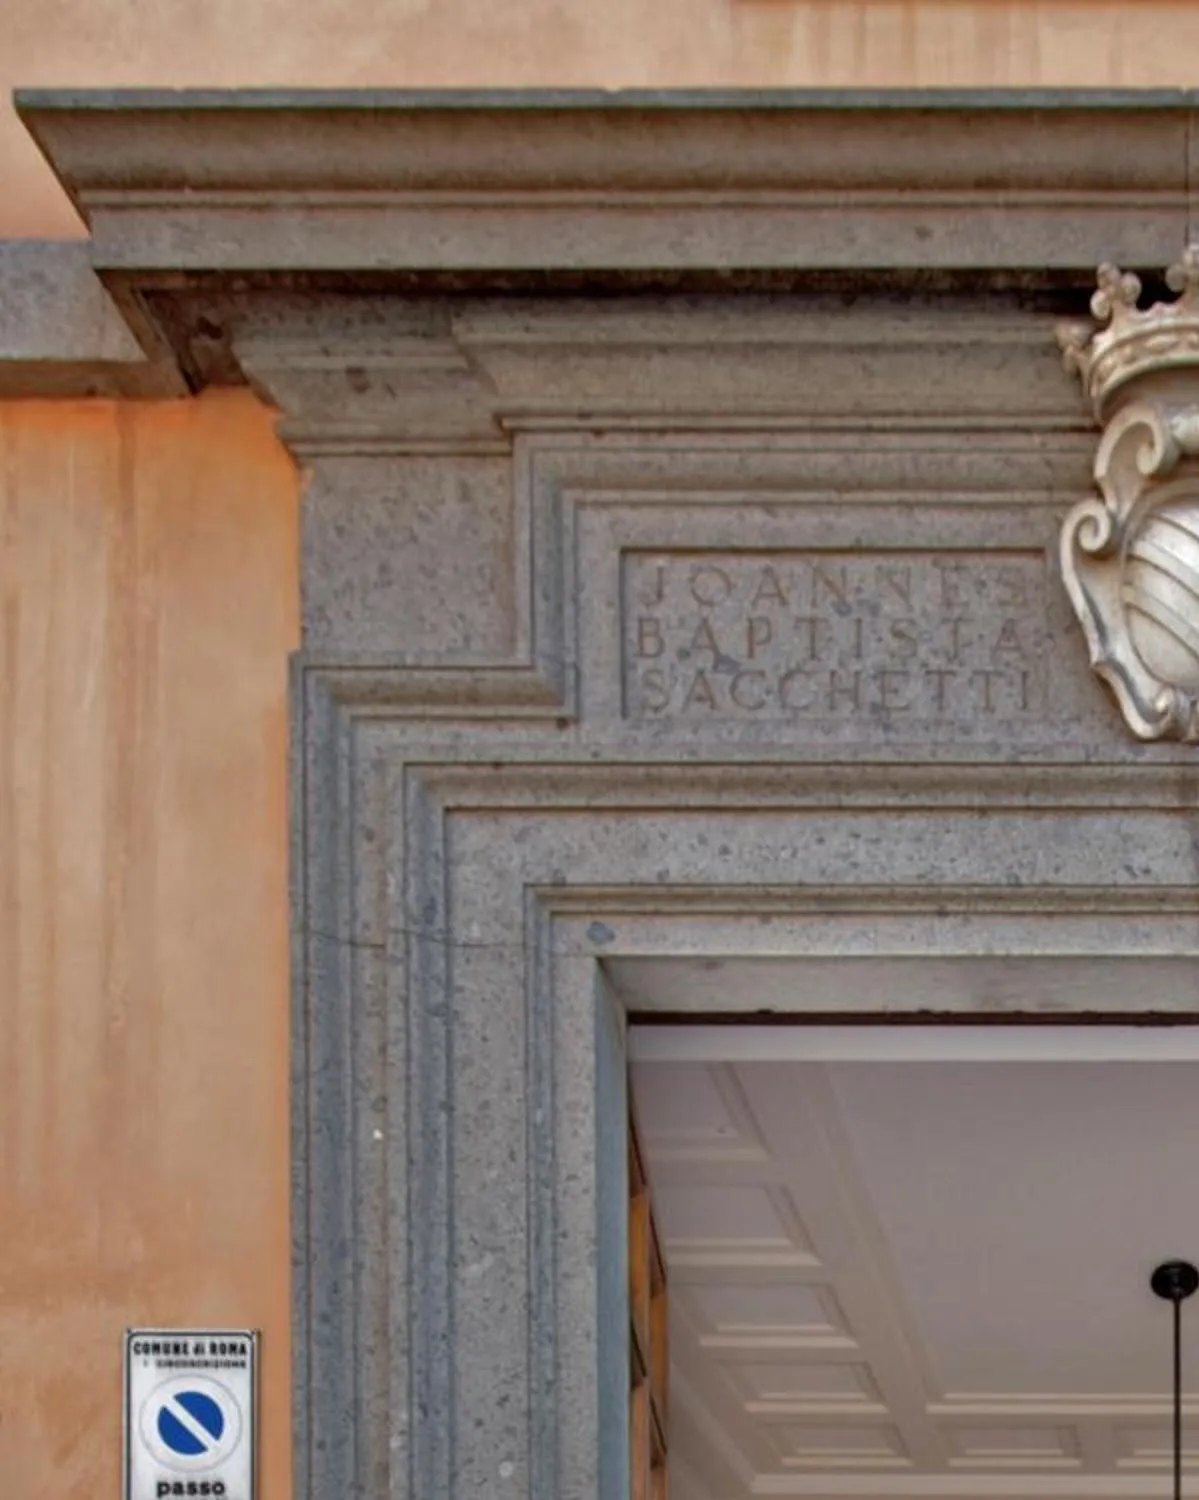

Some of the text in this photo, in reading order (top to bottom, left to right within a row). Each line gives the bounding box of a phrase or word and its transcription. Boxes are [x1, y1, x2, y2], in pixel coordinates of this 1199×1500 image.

[634, 616, 1026, 662] BAPTISTA
[638, 668, 1032, 714] SACCHETTI
[133, 1342, 247, 1356] COMUNE di ROMA
[156, 1481, 226, 1499] passo
